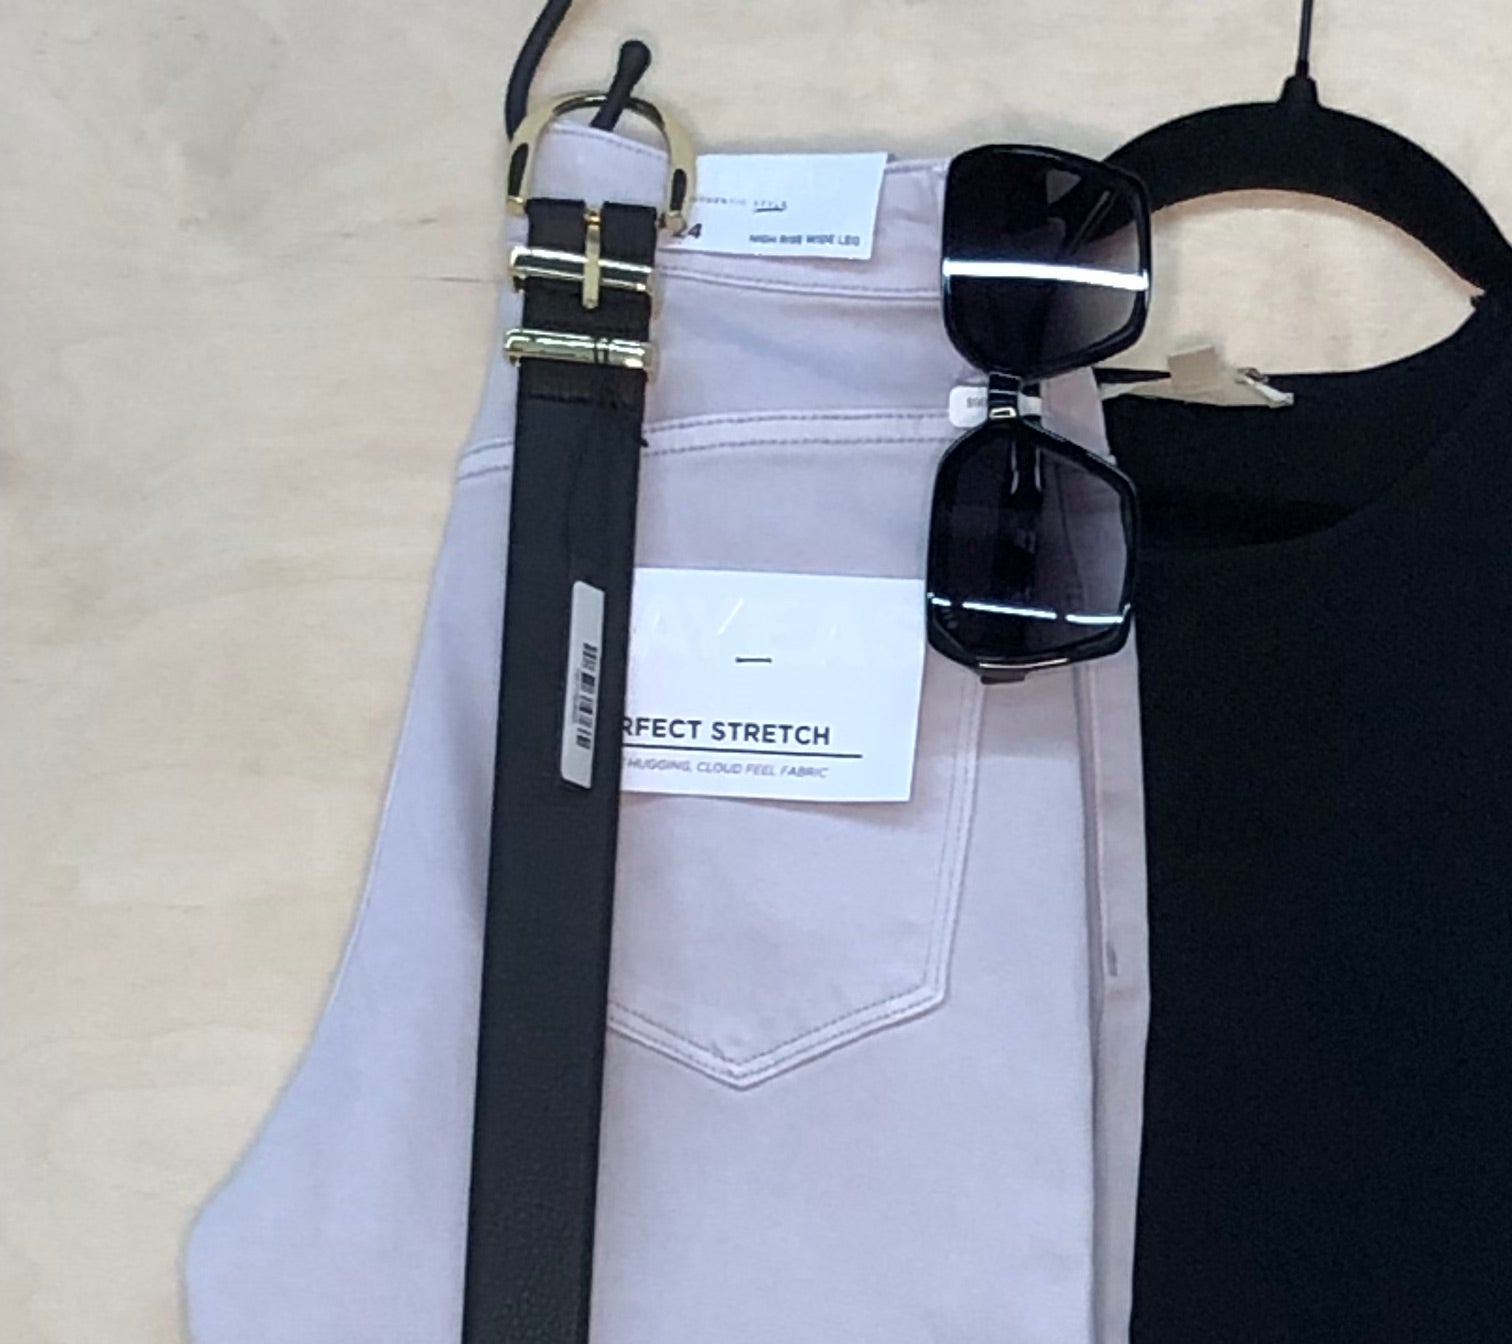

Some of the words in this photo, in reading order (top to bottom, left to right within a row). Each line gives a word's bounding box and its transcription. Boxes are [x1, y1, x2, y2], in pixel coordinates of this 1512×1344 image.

[622, 716, 702, 740] RFECT
[711, 721, 830, 746] STRETCH
[696, 761, 743, 774] CLOUD
[745, 763, 776, 776] FEEL
[780, 765, 830, 778] FABRIC
